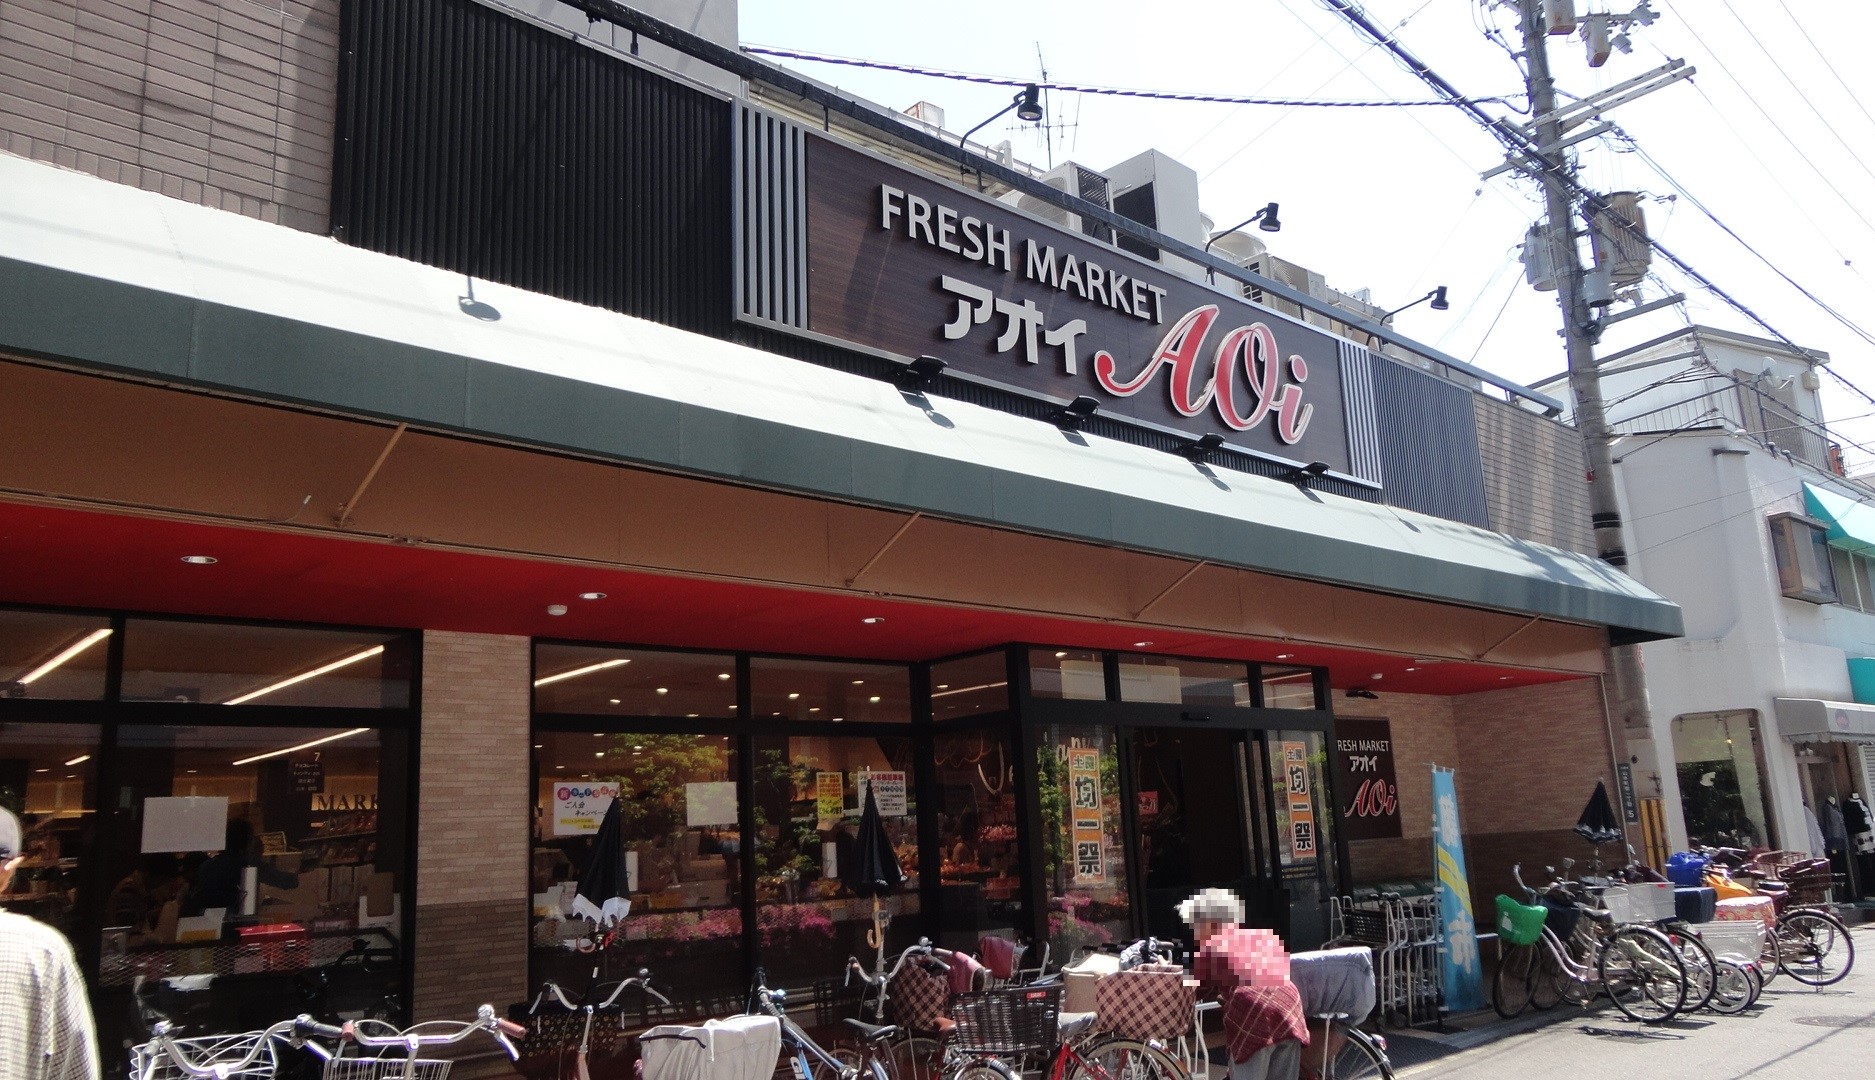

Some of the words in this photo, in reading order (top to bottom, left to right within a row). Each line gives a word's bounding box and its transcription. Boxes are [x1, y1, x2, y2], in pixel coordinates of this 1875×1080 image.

[881, 184, 1012, 272] FRESH
[1026, 238, 1167, 325] MARKET
[941, 274, 1088, 376] アオイ
[1337, 739, 1358, 752] RESH
[1359, 740, 1389, 752] MARKET
[1350, 754, 1378, 772] アオイ
[1074, 774, 1102, 878] 均一祭
